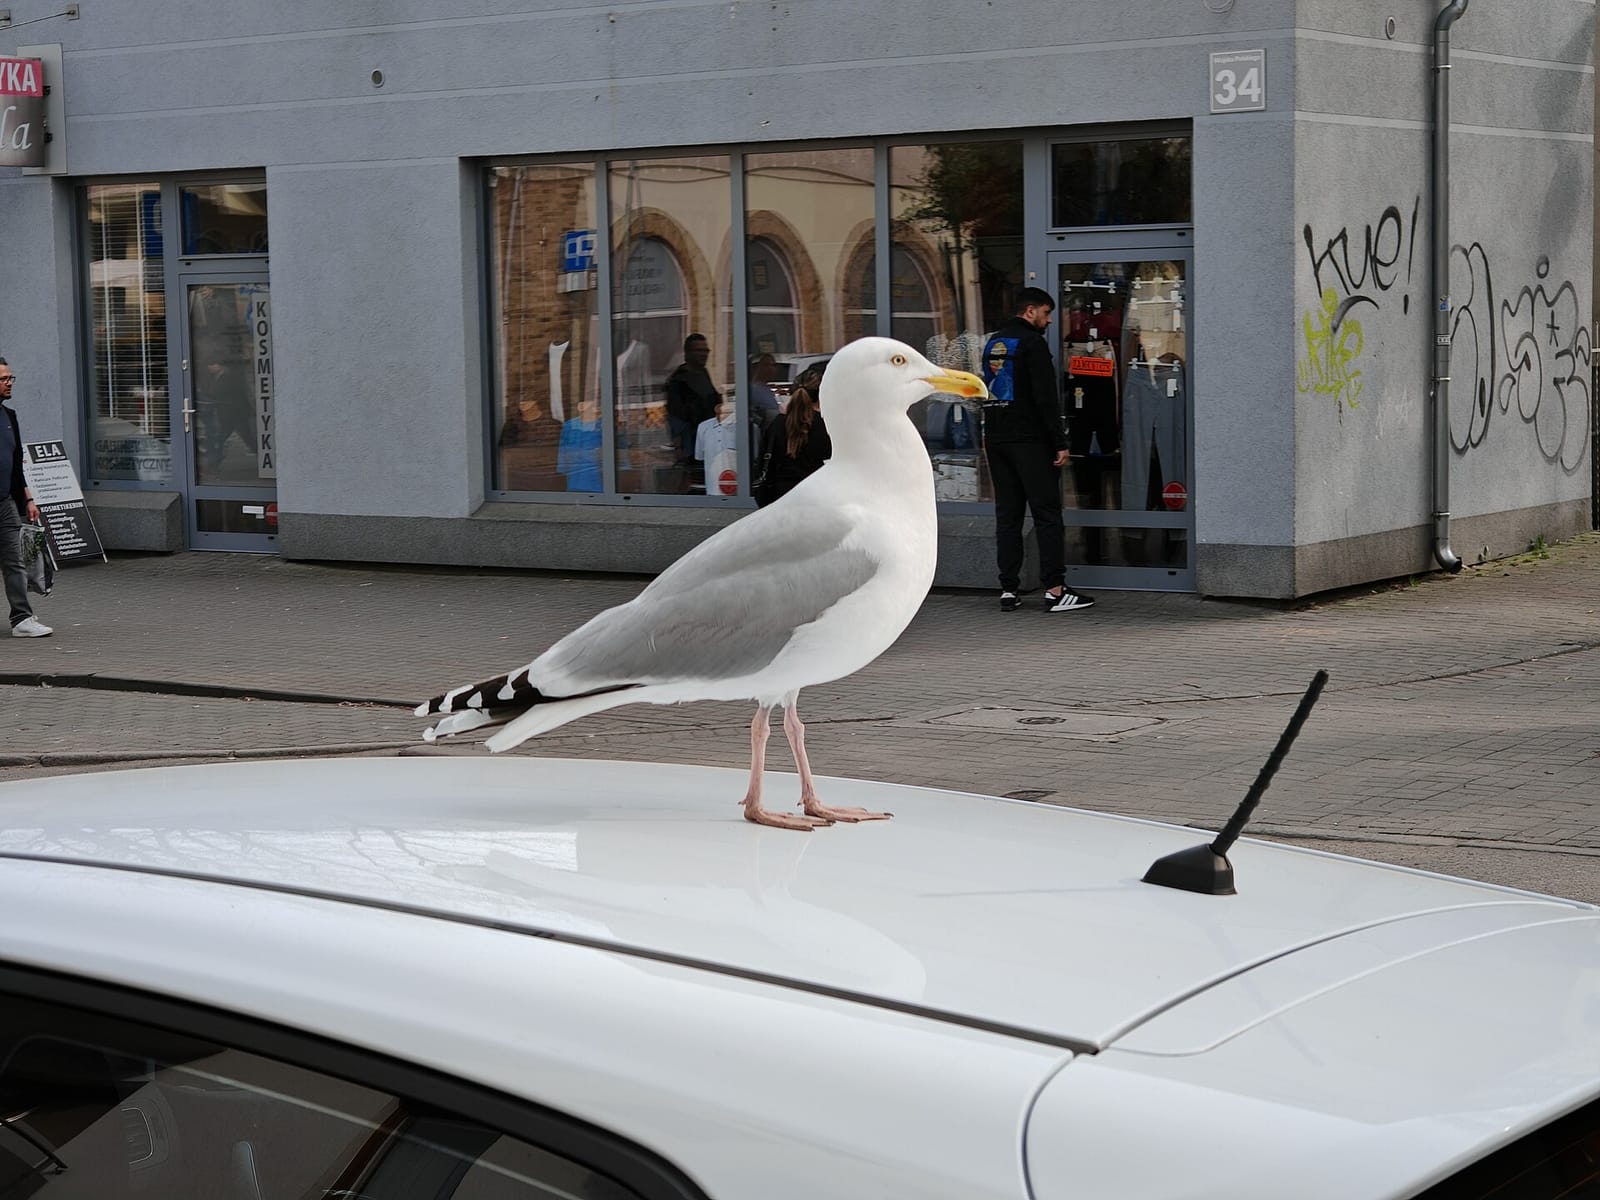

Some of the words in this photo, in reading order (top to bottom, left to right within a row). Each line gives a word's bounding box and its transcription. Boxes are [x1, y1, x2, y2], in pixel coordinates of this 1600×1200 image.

[1214, 67, 1262, 105] 34
[256, 301, 273, 469] KOSMETYKA
[34, 443, 62, 458] ELA
